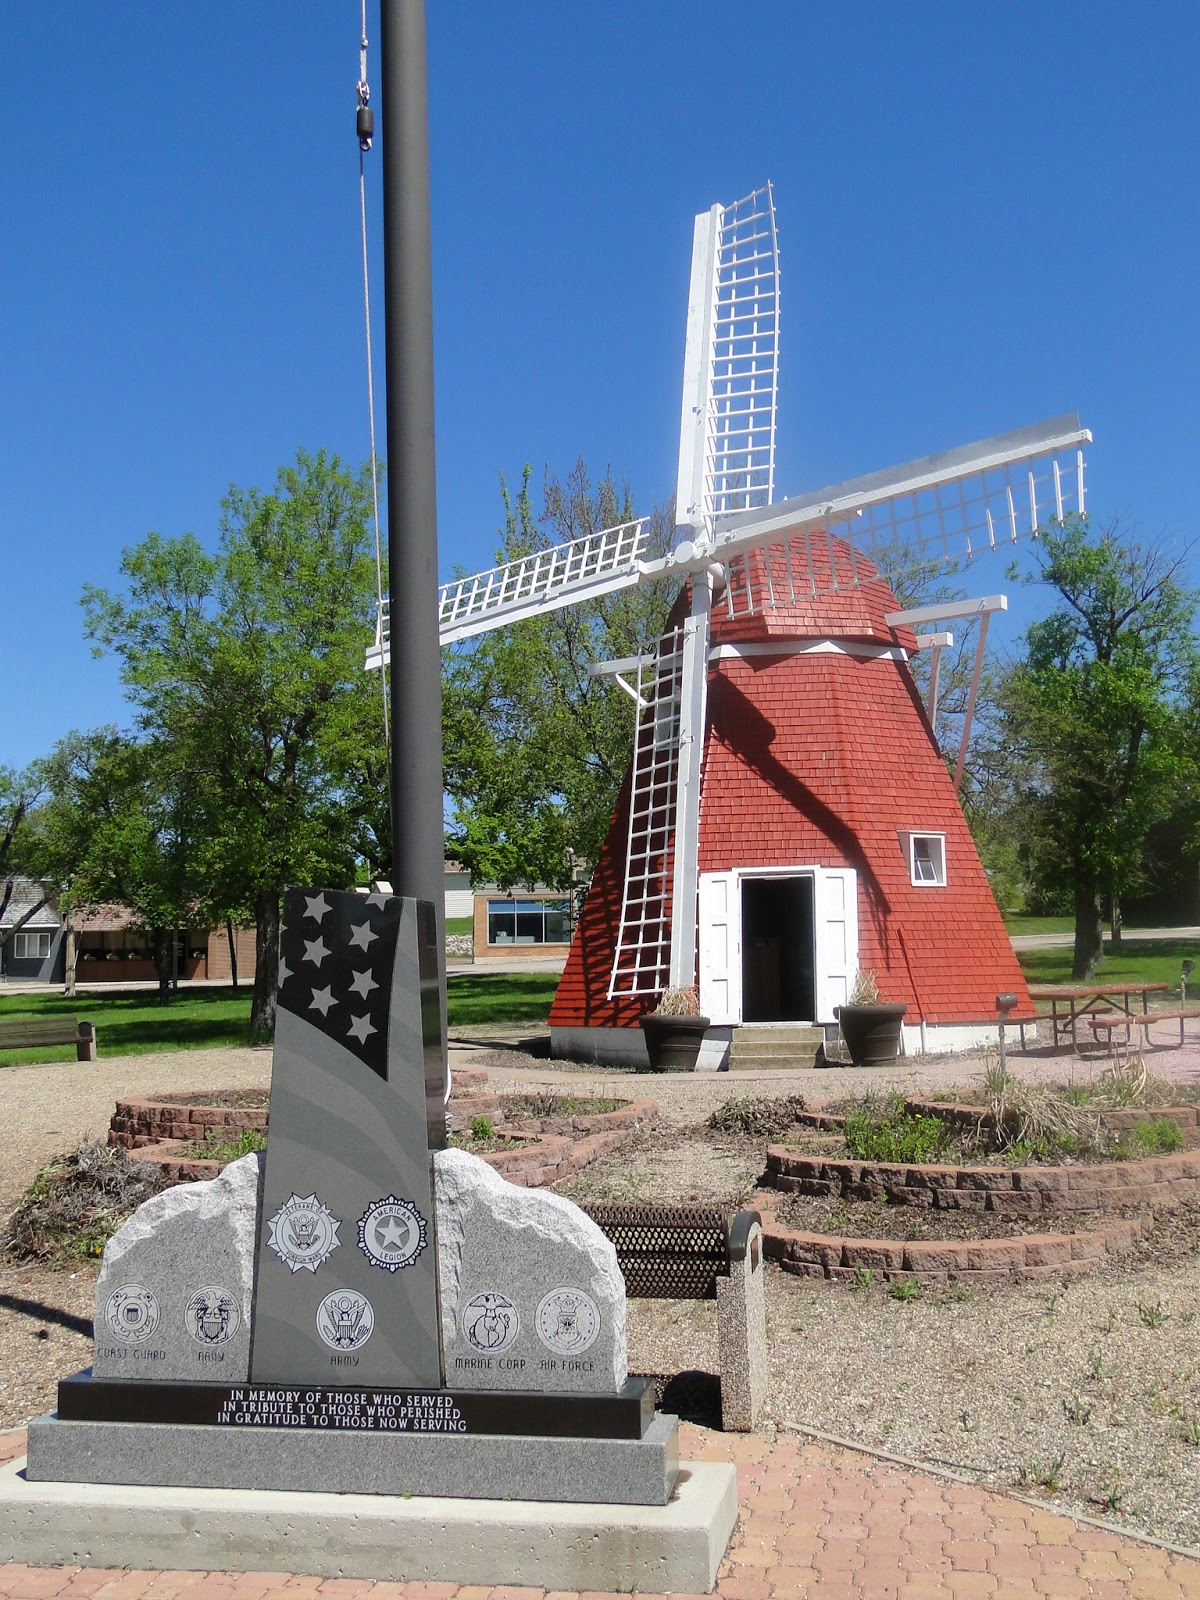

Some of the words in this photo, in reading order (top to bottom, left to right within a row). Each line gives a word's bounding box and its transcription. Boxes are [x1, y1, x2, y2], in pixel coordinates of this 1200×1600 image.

[285, 1203, 313, 1216] VETERANS
[315, 1207, 323, 1215] OF
[372, 1206, 412, 1222] AMERICAN
[286, 1251, 306, 1263] FOREIGN
[306, 1252, 322, 1263] WARS
[379, 1251, 407, 1261] LEGION
[97, 1347, 128, 1359] COAST
[133, 1349, 166, 1360] GUARD
[198, 1351, 225, 1362] NAVY
[330, 1355, 360, 1367] ARMY
[455, 1357, 492, 1369] MARINE
[498, 1358, 526, 1370] CORP
[540, 1359, 557, 1371] AIR
[562, 1360, 595, 1372] FORCE
[231, 1390, 244, 1401] IN
[248, 1390, 300, 1402] MEMORY
[306, 1392, 322, 1403] OF
[326, 1392, 367, 1405] THOSE
[372, 1394, 402, 1406] WHO
[406, 1395, 453, 1408] SERVED
[223, 1401, 236, 1412] IN
[241, 1401, 294, 1414] TRIBUTE
[298, 1403, 315, 1414] TO
[320, 1404, 361, 1416] THOSE
[366, 1405, 395, 1417] WHO
[400, 1406, 461, 1420] PERISHED
[217, 1412, 230, 1423] IN
[235, 1412, 306, 1425] GRATITUDE
[312, 1415, 328, 1426] TO
[333, 1415, 375, 1428] THOSE
[379, 1417, 408, 1429] NOW
[413, 1418, 467, 1432] SERVING
